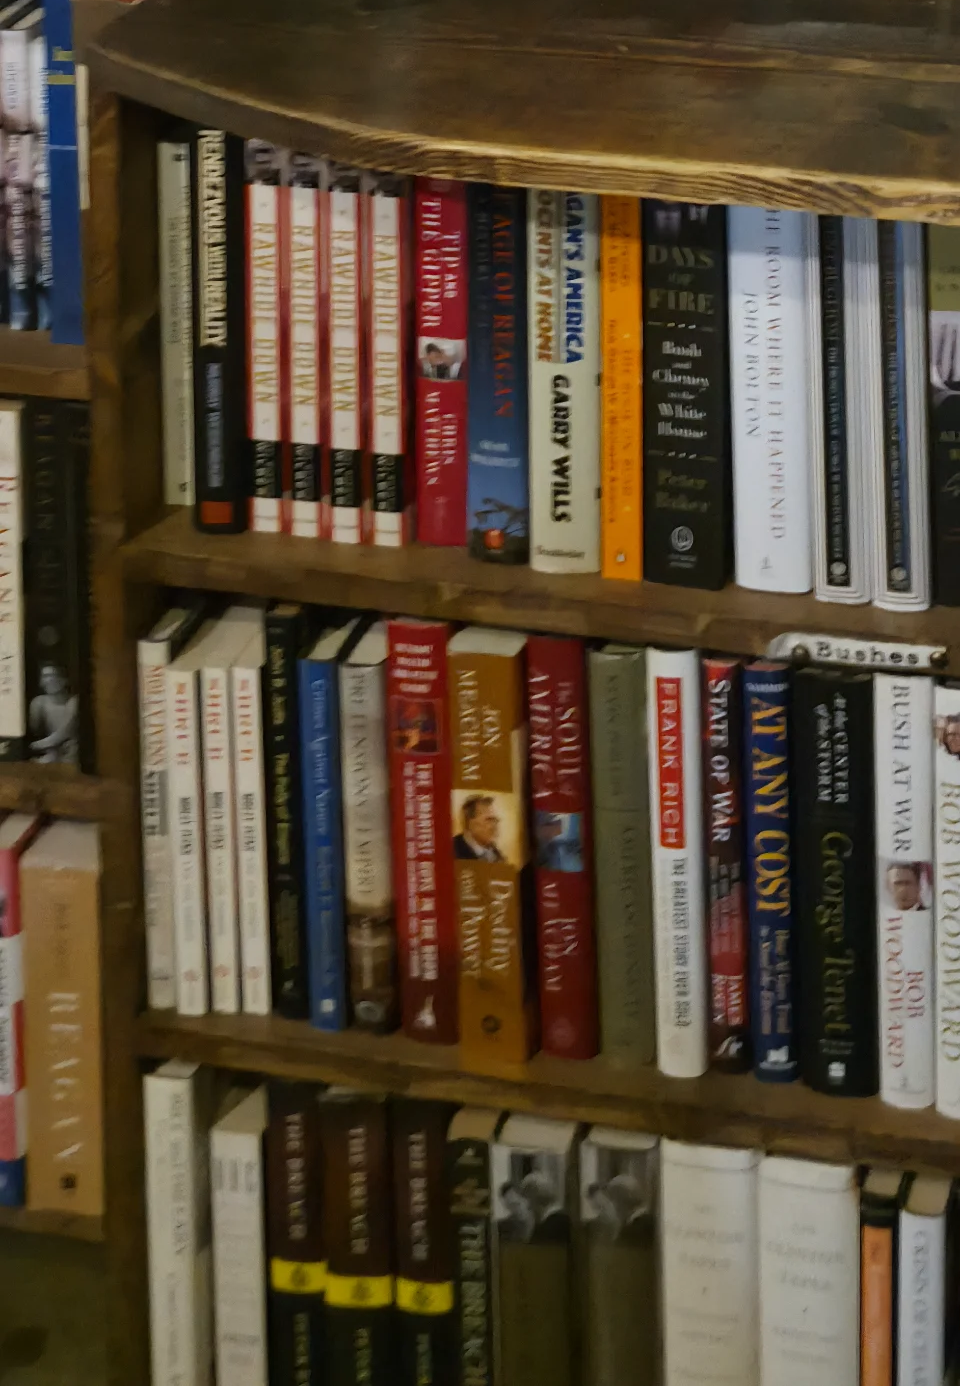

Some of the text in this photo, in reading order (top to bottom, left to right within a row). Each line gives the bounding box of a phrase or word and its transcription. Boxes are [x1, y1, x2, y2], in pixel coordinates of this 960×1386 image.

[551, 374, 572, 524] GARRY WILLS
[815, 642, 919, 666] Bushes
[660, 684, 683, 845] FRANK RICH
[708, 678, 732, 842] STATE OF WAR
[751, 698, 789, 916] AT ANY COST
[893, 685, 912, 854] BUSH AT WAR
